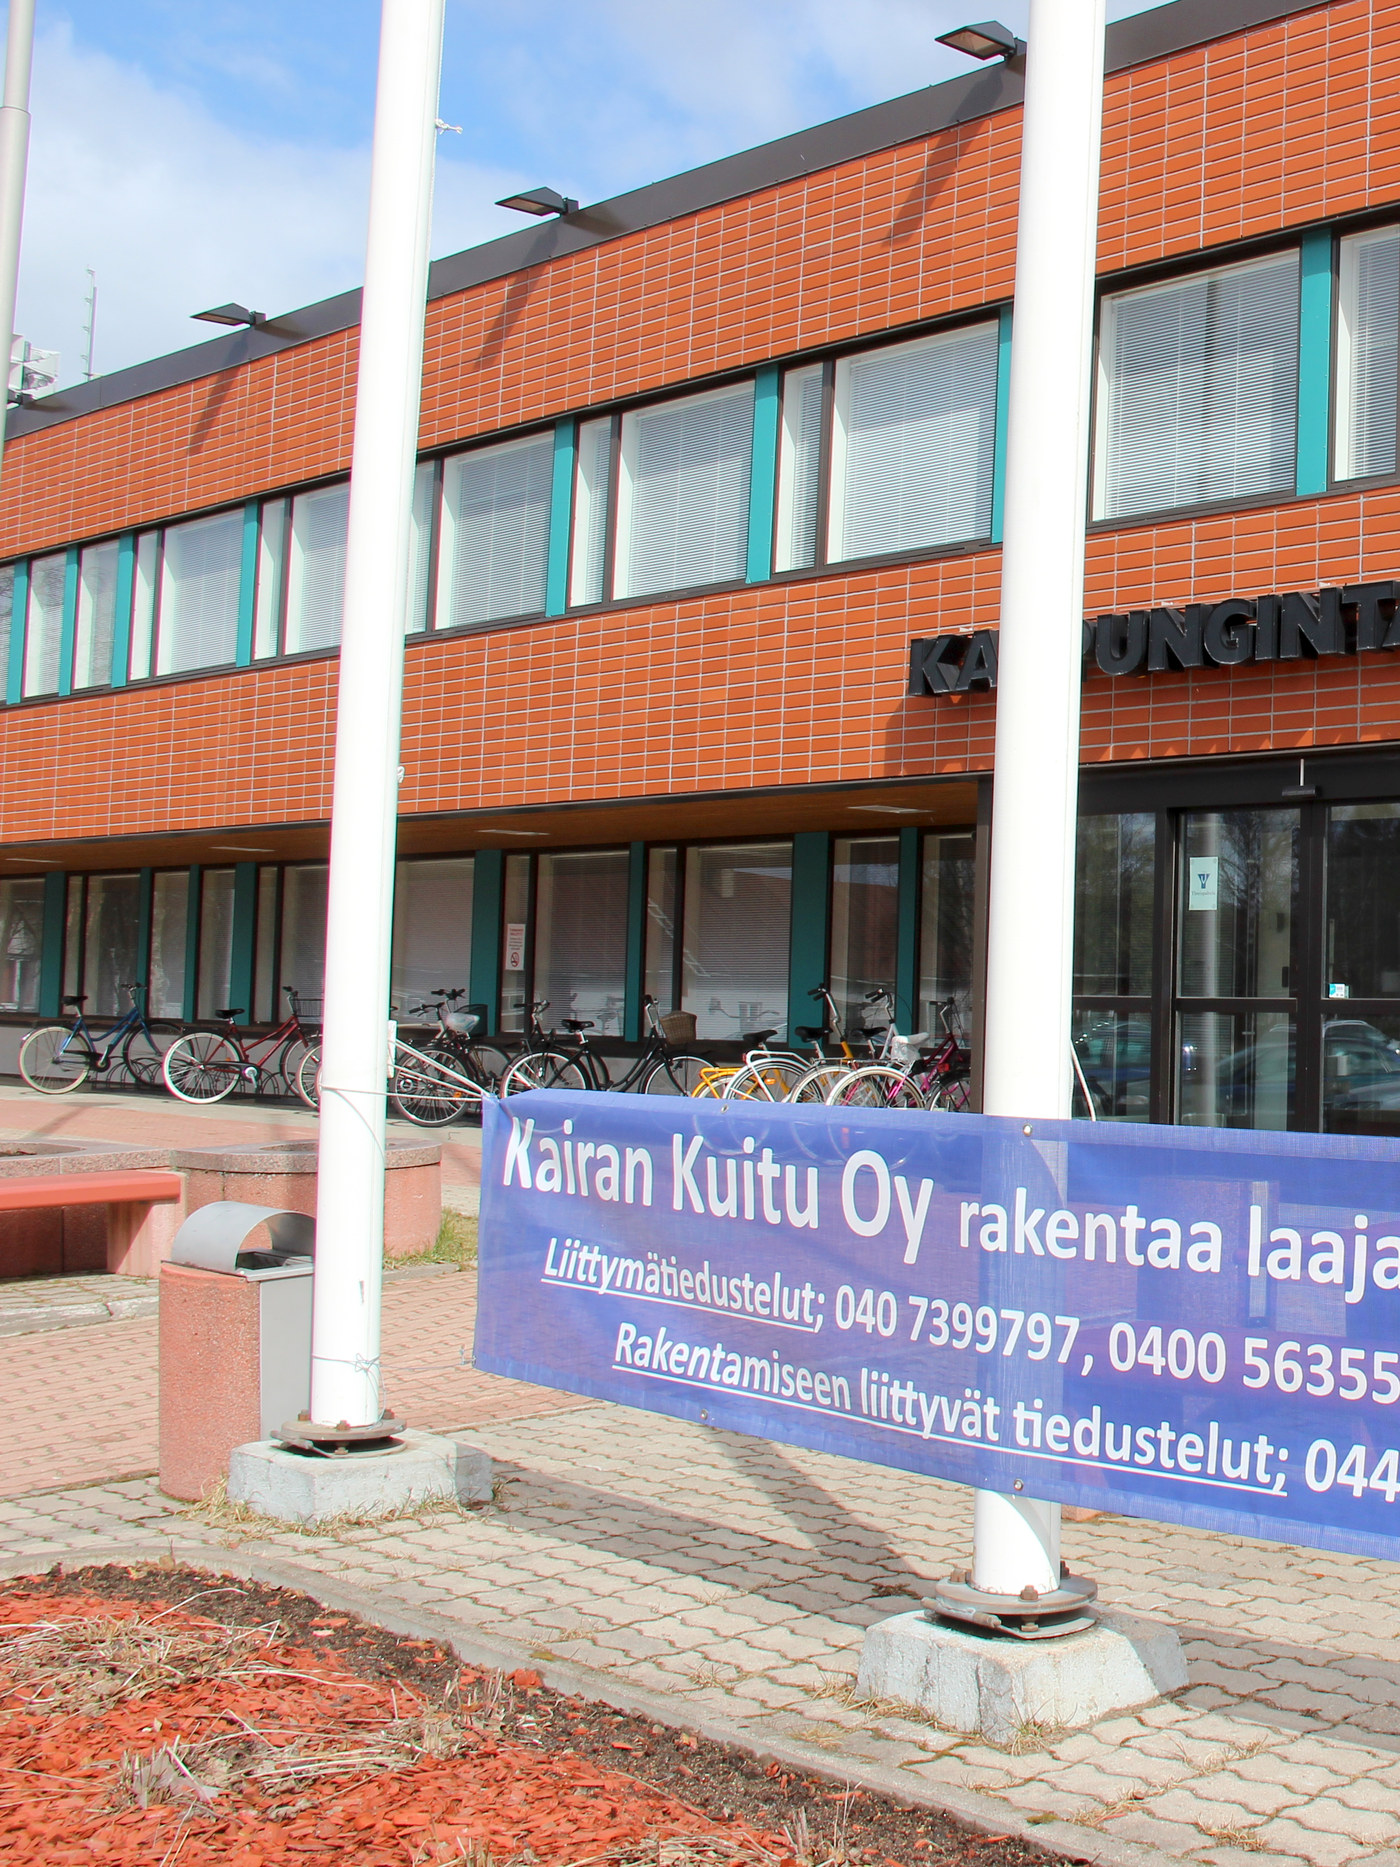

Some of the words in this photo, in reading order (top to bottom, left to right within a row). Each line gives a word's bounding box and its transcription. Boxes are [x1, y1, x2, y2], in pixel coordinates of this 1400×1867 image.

[502, 1116, 653, 1207] Kairan
[672, 1133, 819, 1229] Kuitu
[841, 1150, 934, 1265] Oy
[959, 1187, 1223, 1273] rakentaa
[543, 1236, 826, 1333] Liittymätiedustelut;
[835, 1284, 898, 1338] 040
[908, 1295, 1094, 1377] 7399797,
[1108, 1322, 1228, 1383] 0400
[614, 1322, 852, 1412] Rakentamiseen
[859, 1367, 1001, 1443] liittyvät
[1012, 1397, 1289, 1496] tiedustelut;
